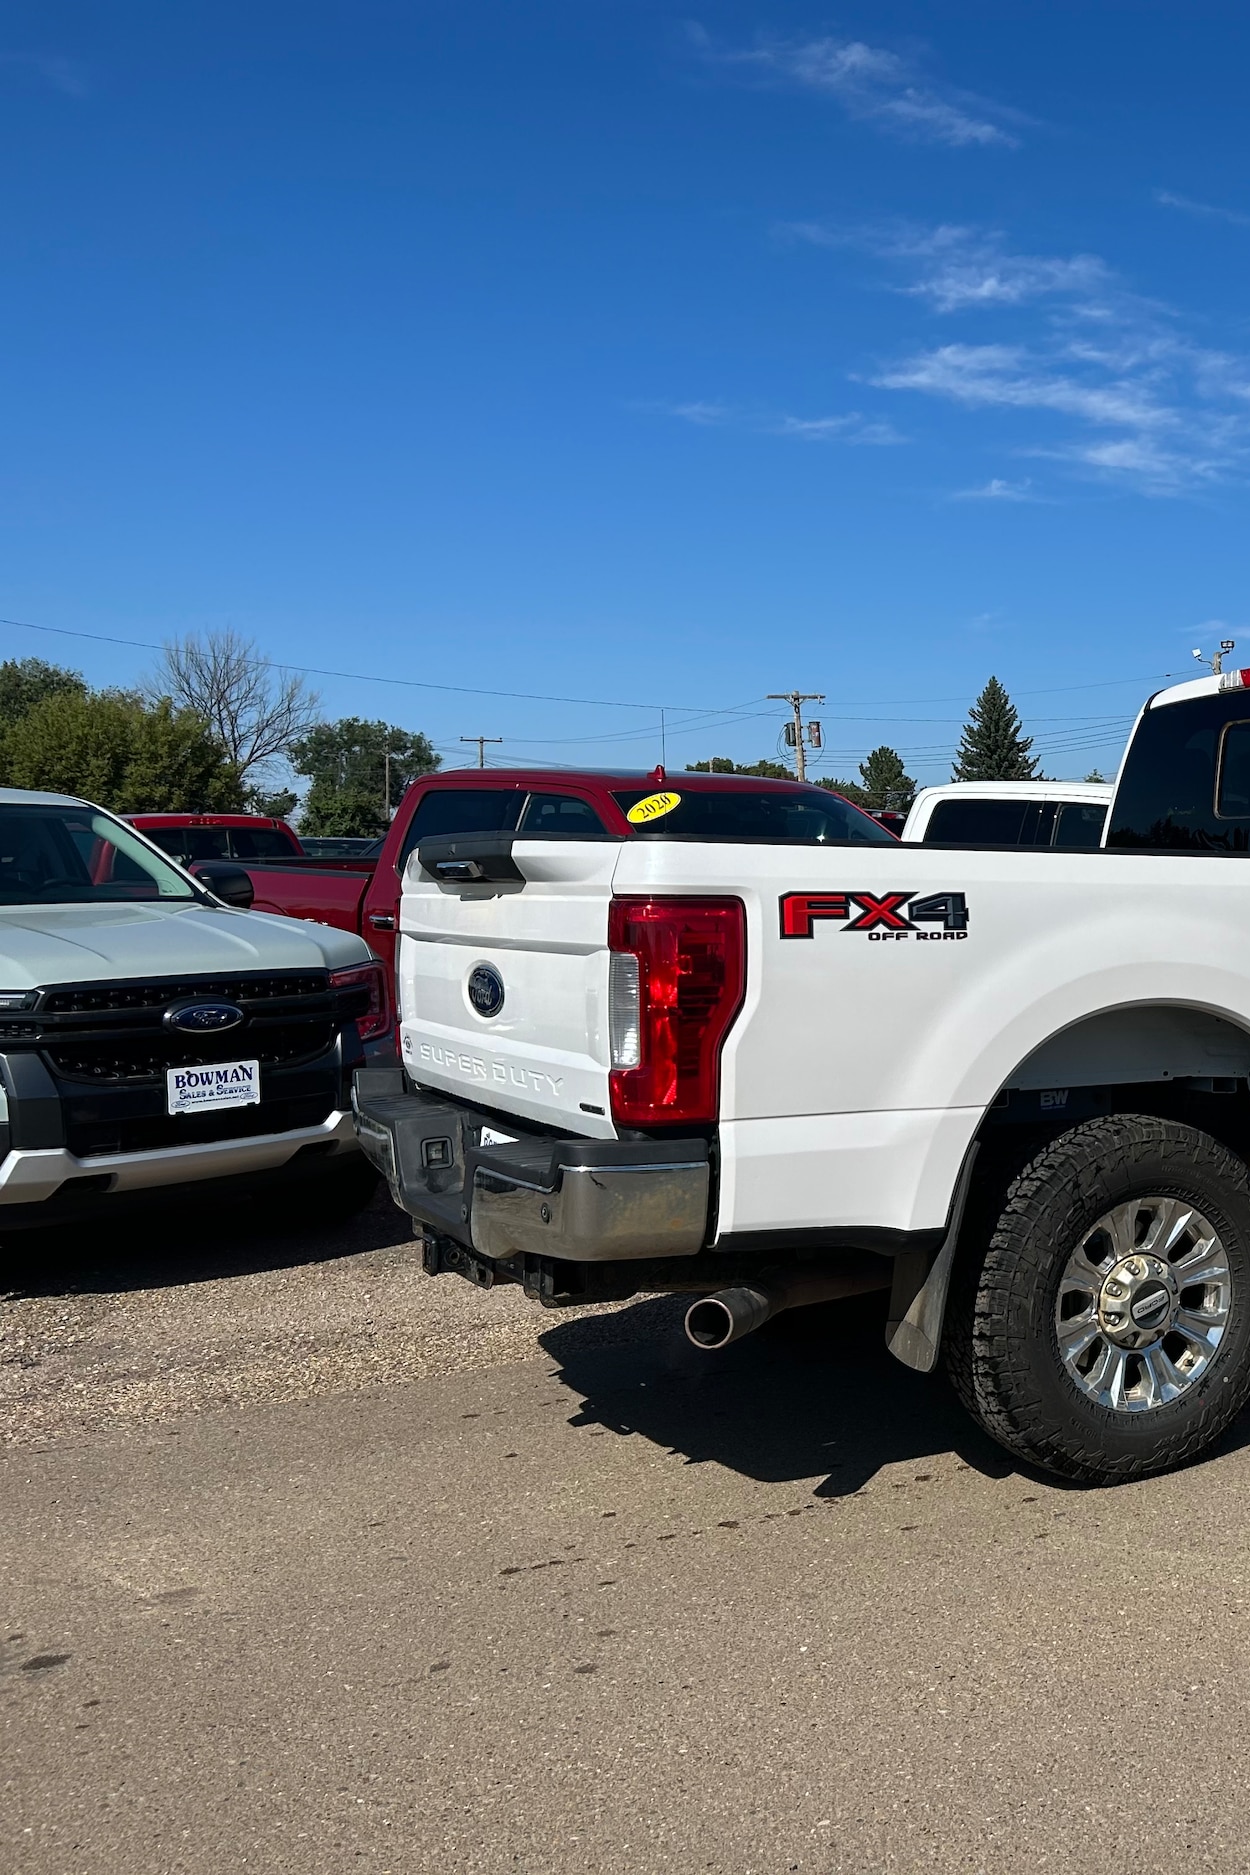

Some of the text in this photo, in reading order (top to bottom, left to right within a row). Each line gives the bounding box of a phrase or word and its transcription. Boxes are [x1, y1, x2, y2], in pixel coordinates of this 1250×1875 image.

[637, 794, 671, 819] 2020
[778, 891, 969, 939] FX4
[868, 931, 969, 941] OFF ROAD
[175, 1067, 253, 1089] BOWMAN
[420, 1043, 487, 1081] SUPER
[492, 1062, 564, 1096] DUTY
